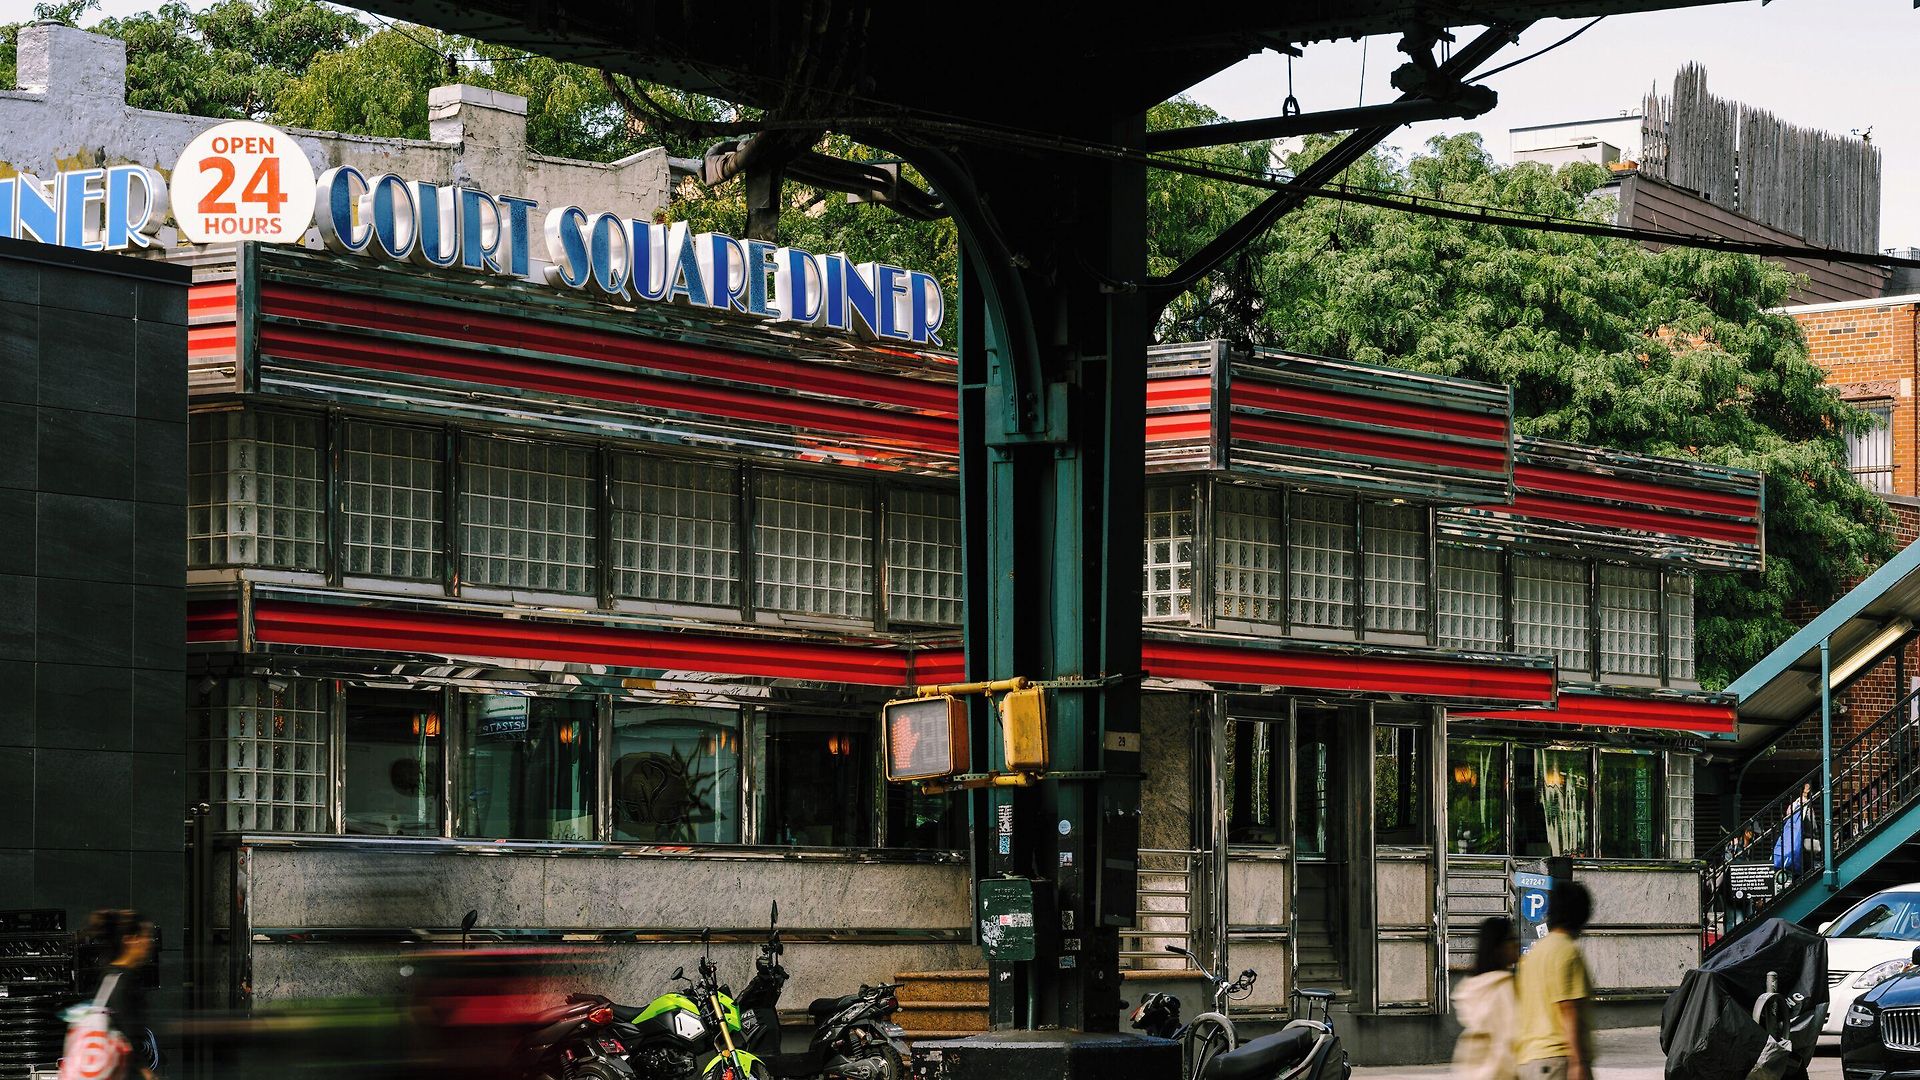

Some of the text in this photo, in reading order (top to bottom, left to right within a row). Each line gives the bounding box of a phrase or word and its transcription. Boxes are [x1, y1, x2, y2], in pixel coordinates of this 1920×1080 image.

[211, 136, 275, 155] OPEN
[198, 156, 288, 214] 24
[204, 216, 282, 235] HOURS
[320, 164, 945, 347] COURT SQUARE DINER
[1521, 878, 1546, 886] 427247
[1526, 893, 1544, 918] P
